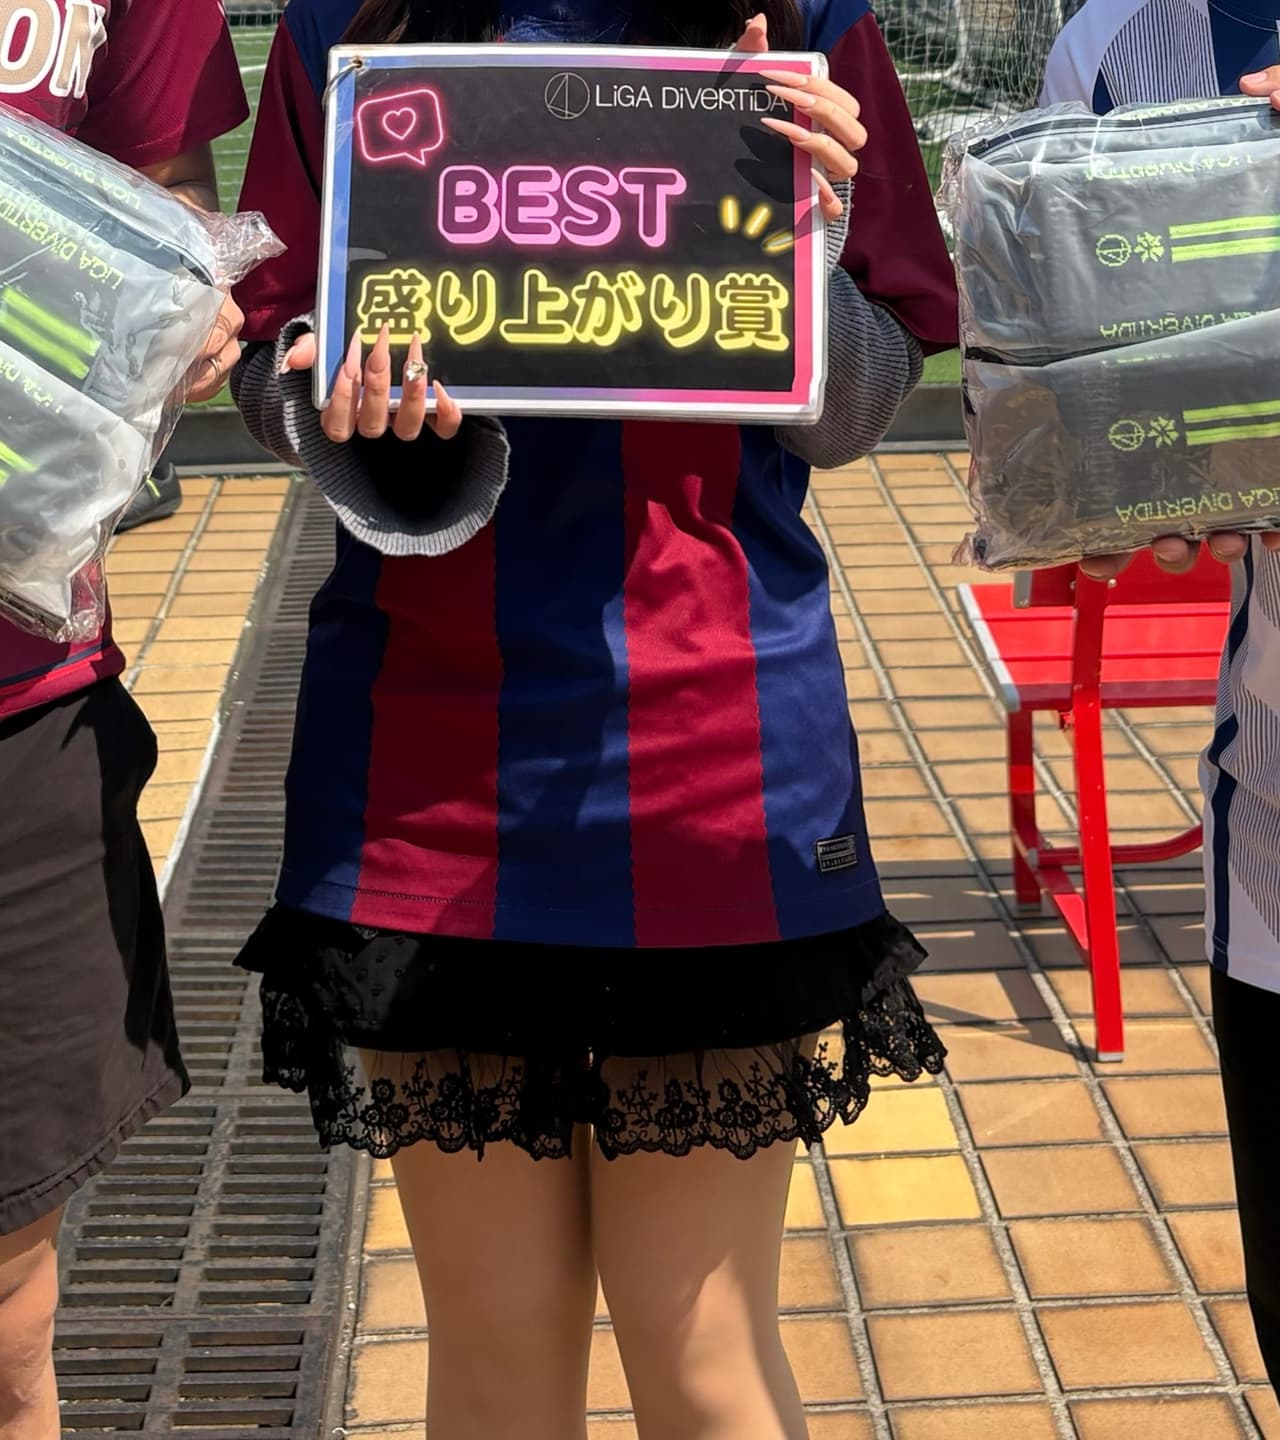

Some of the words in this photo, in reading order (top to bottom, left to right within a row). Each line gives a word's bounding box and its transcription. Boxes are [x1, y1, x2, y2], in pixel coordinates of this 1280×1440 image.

[437, 164, 686, 248] BEST
[358, 267, 790, 352] 盛り上がり賞
